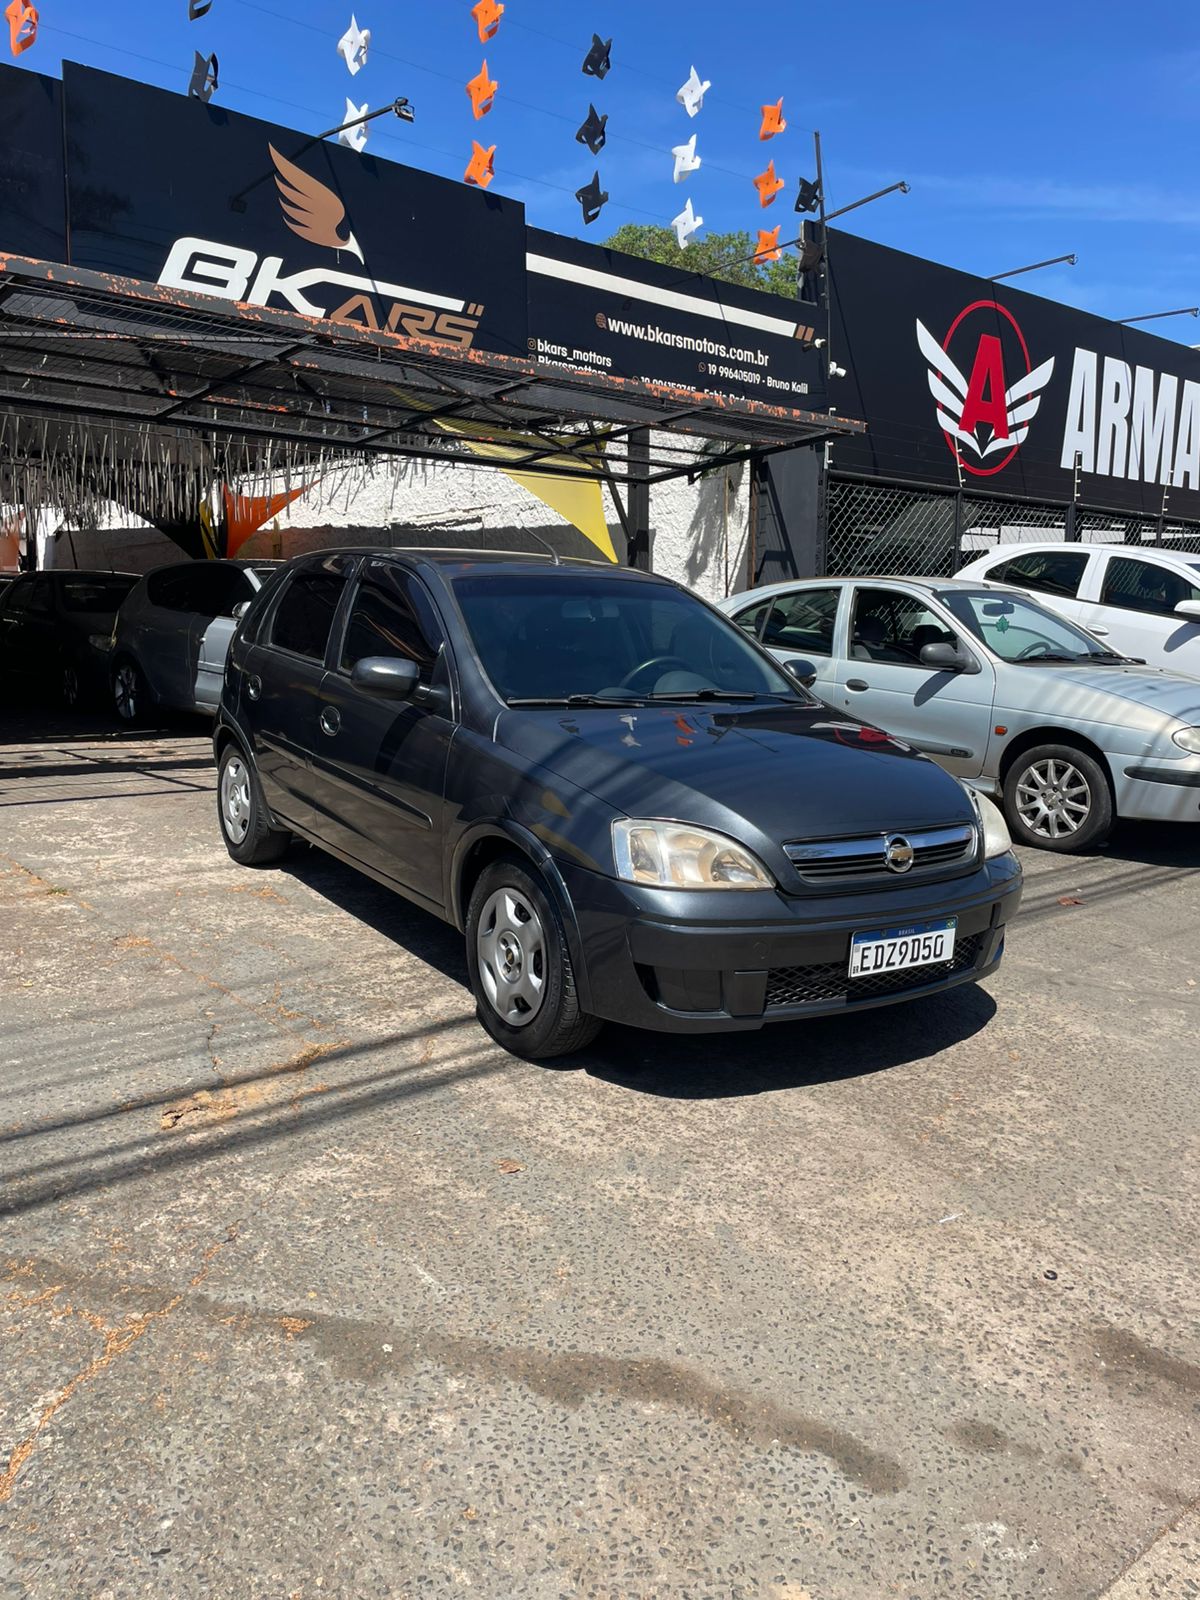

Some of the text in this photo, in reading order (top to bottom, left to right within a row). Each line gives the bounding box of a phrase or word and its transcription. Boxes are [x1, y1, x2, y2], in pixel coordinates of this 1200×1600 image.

[537, 339, 612, 367] bkars_mottors
[608, 318, 769, 366] www.bkarsmotors.com.br
[708, 363, 717, 375] 19
[719, 366, 761, 384] 996405019
[767, 376, 790, 391] Bruno
[1060, 347, 1200, 491] ARMA
[860, 934, 944, 972] EDZ9D50
